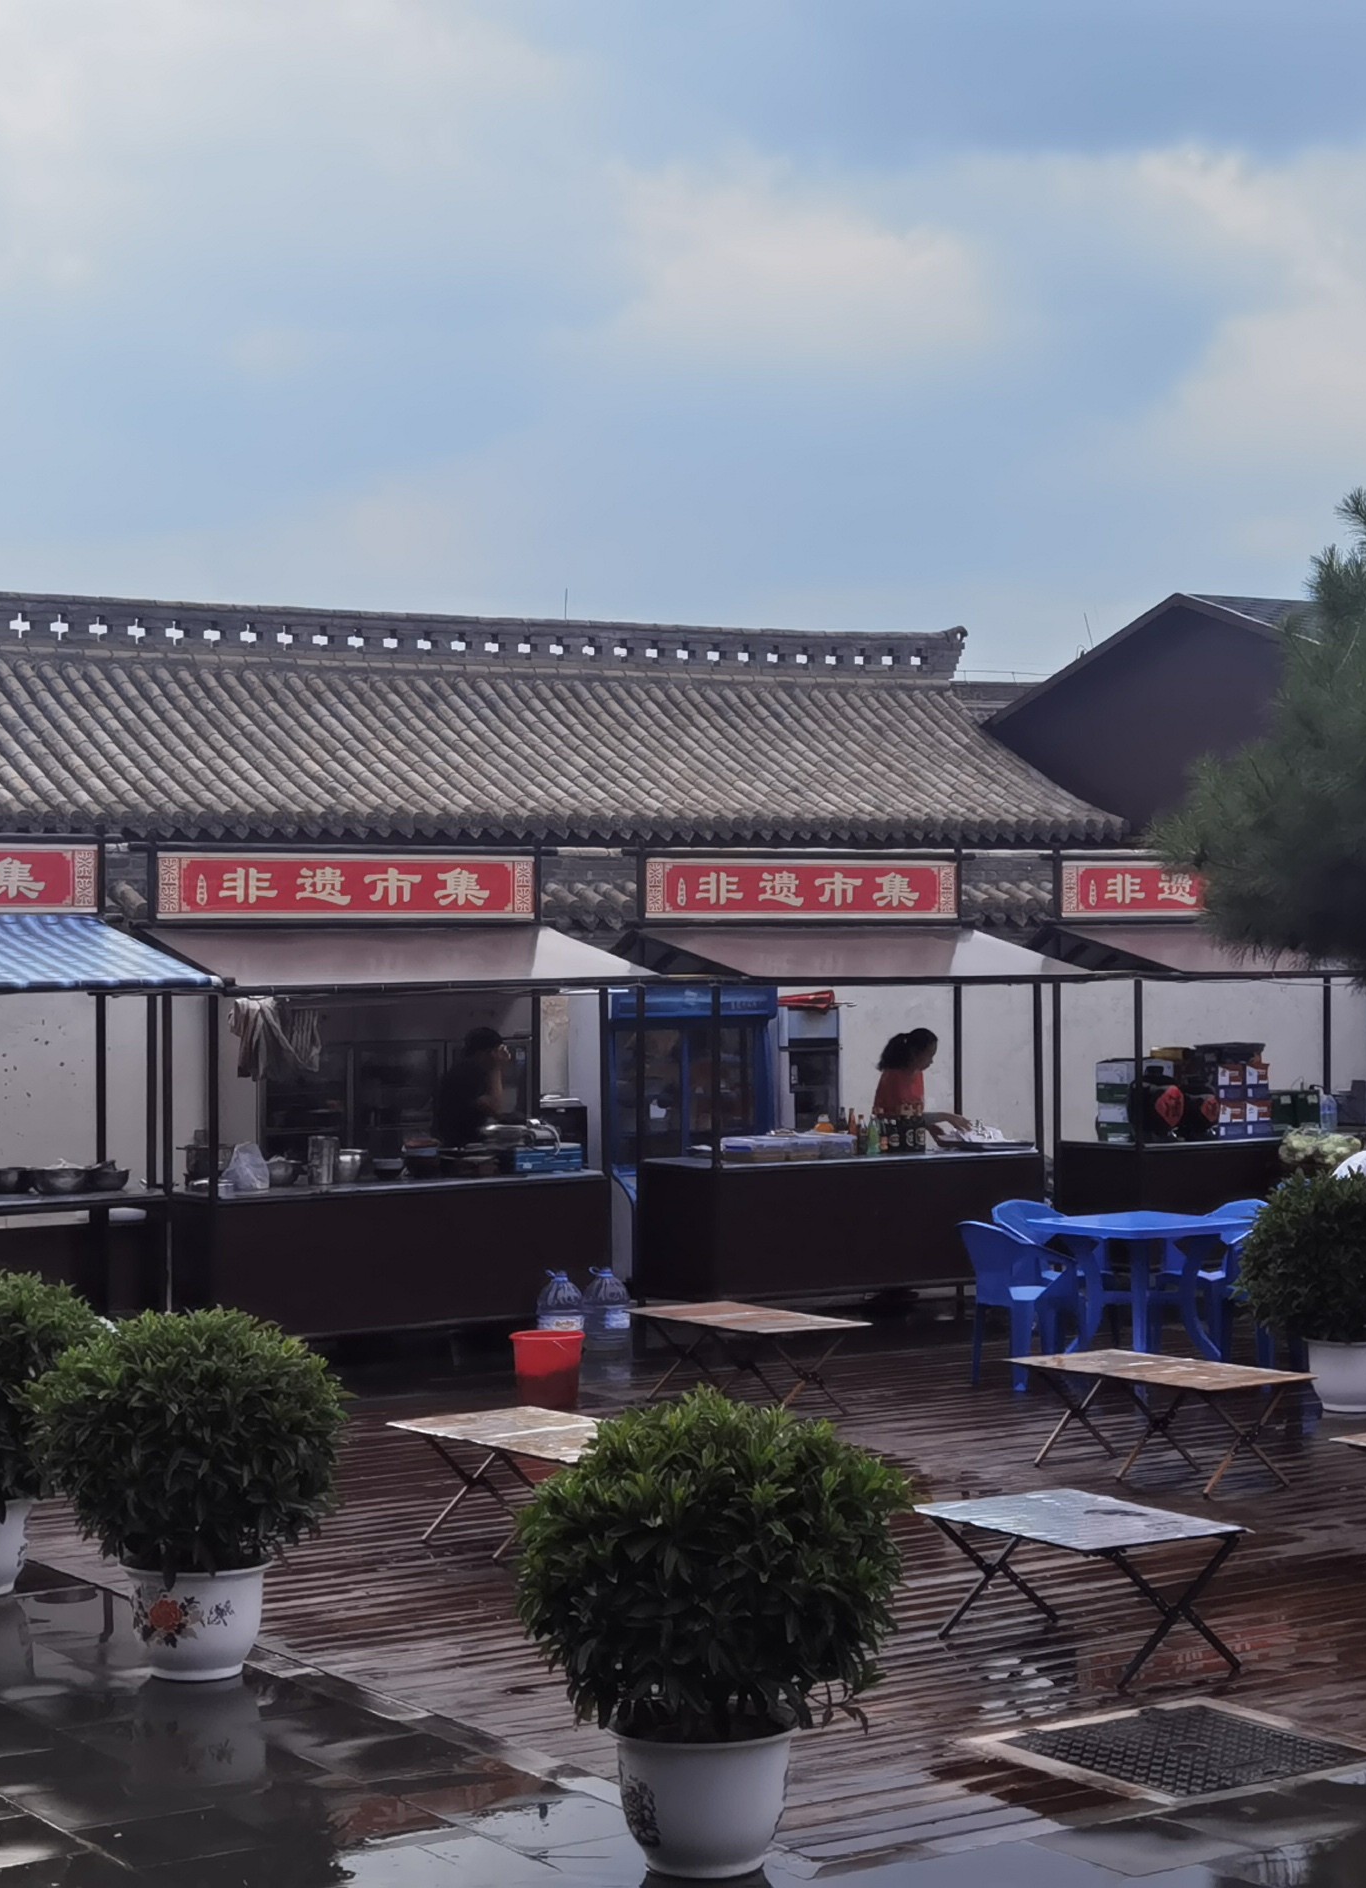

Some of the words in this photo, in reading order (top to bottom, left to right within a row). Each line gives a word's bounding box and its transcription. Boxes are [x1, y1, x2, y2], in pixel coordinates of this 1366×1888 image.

[219, 867, 490, 906] 非遗市集
[696, 871, 920, 907] 非遗市集
